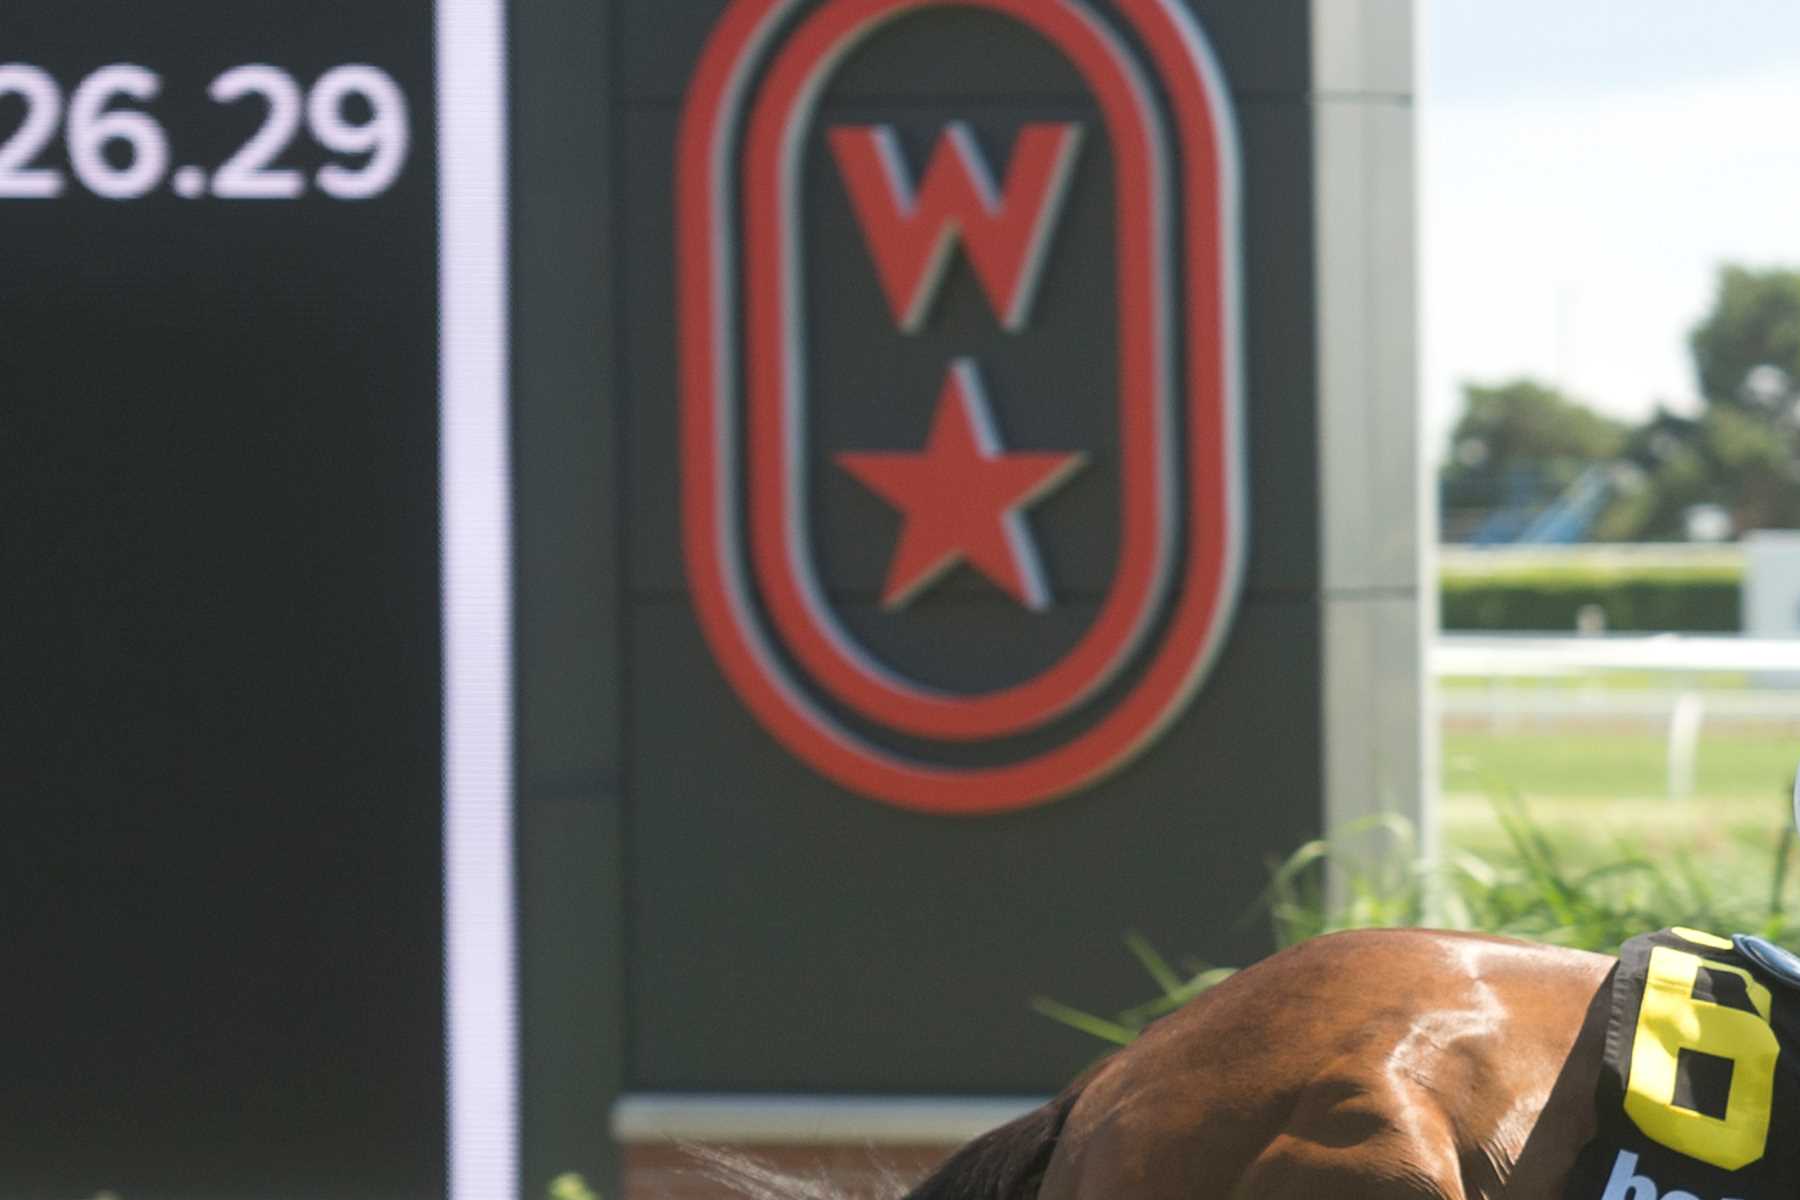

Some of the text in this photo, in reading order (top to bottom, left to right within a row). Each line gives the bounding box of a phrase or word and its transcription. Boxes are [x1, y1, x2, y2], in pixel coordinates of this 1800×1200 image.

[0, 61, 411, 200] 26.29
[828, 122, 1085, 331] W
[1623, 946, 1781, 1171] 6
